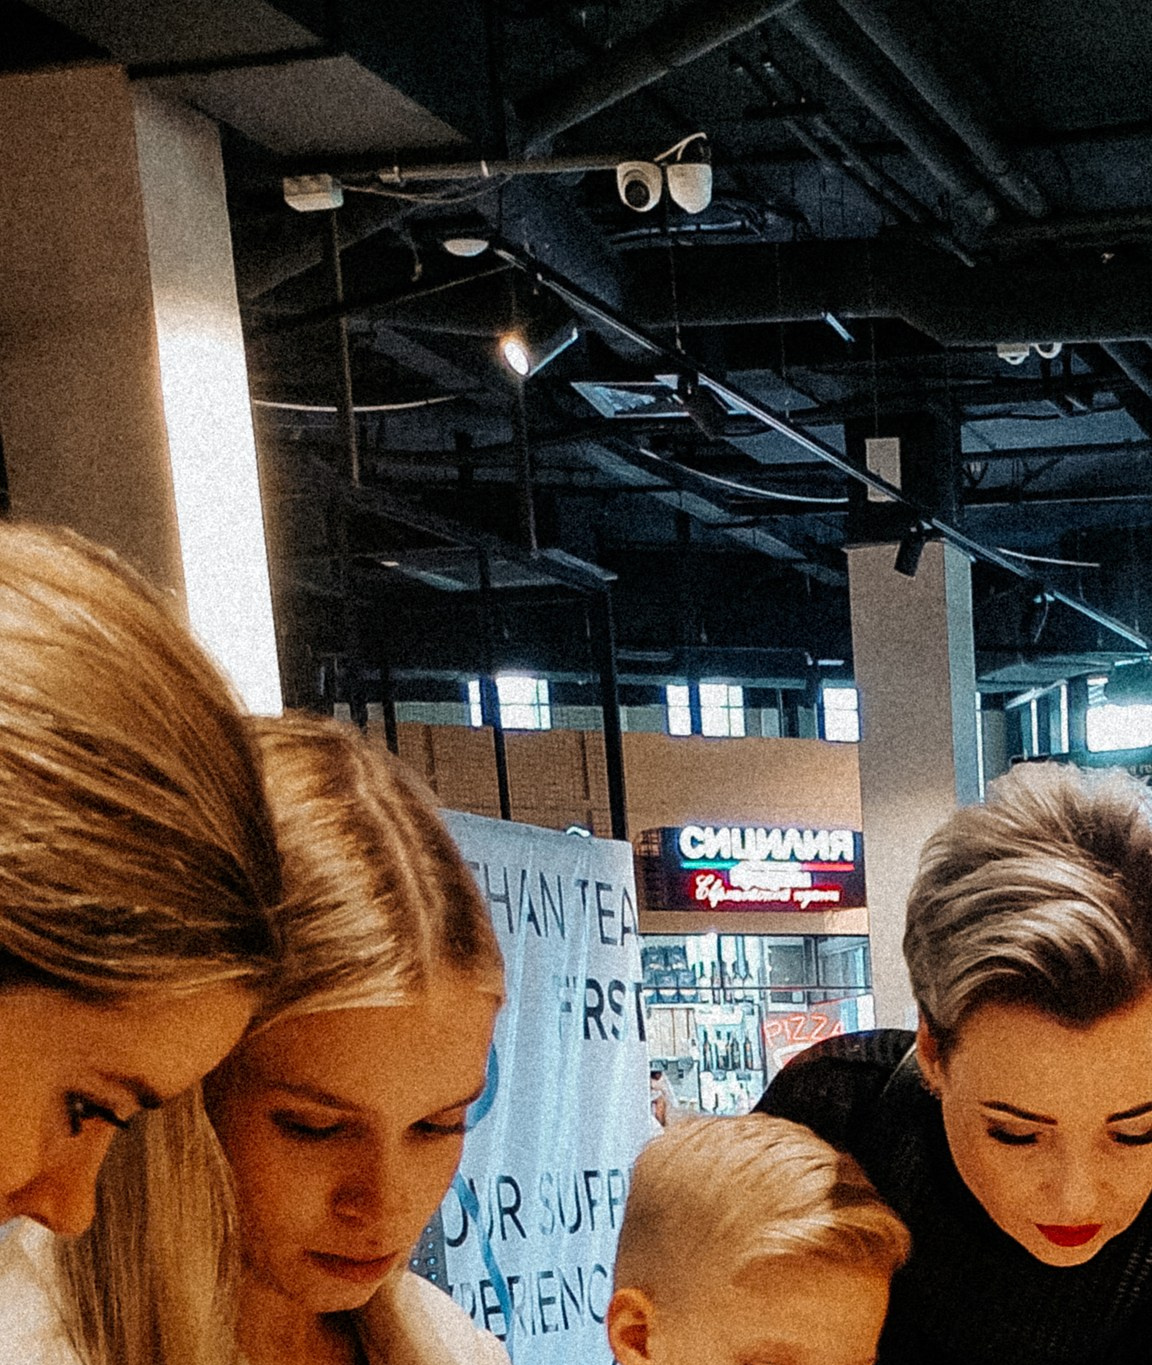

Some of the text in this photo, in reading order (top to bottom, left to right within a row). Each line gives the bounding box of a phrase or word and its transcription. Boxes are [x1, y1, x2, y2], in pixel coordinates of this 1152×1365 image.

[679, 826, 855, 861] СИЦИЛИЯ
[764, 1014, 847, 1047] PIZZA
[449, 1264, 608, 1341] PERIENC
